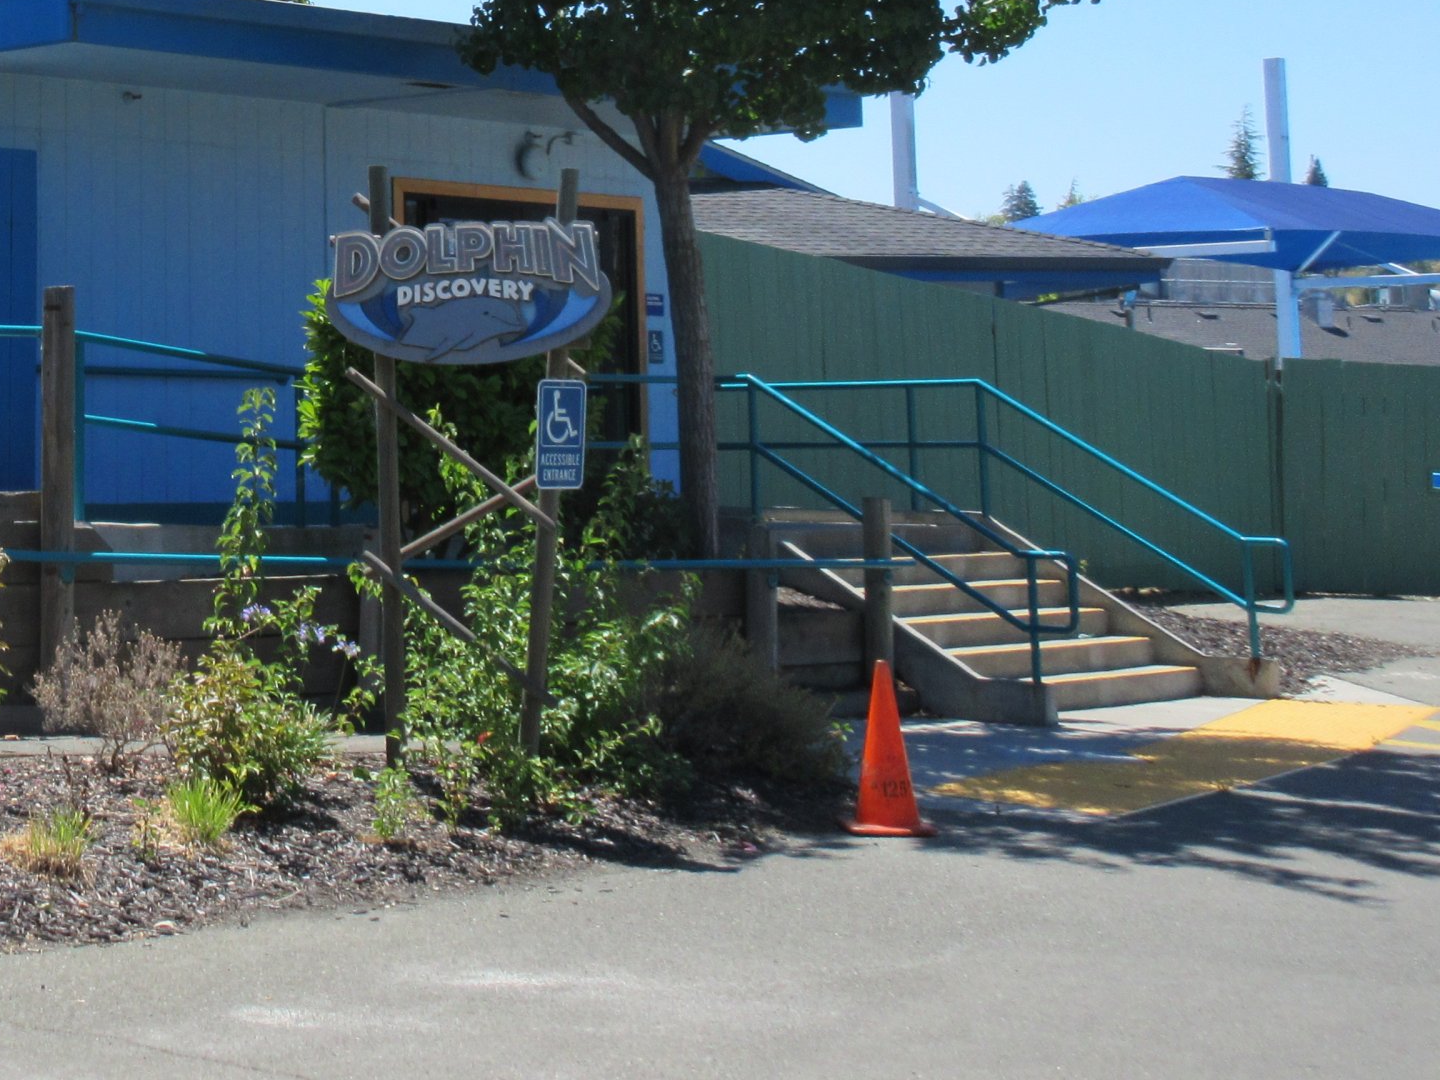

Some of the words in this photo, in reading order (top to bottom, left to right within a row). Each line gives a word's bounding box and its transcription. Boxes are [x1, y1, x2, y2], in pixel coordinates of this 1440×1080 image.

[333, 220, 600, 298] DOLPHIN
[397, 277, 535, 307] DISCOVERY
[540, 453, 581, 466] ACCESSIBLE
[543, 468, 577, 481] ENTRANCE
